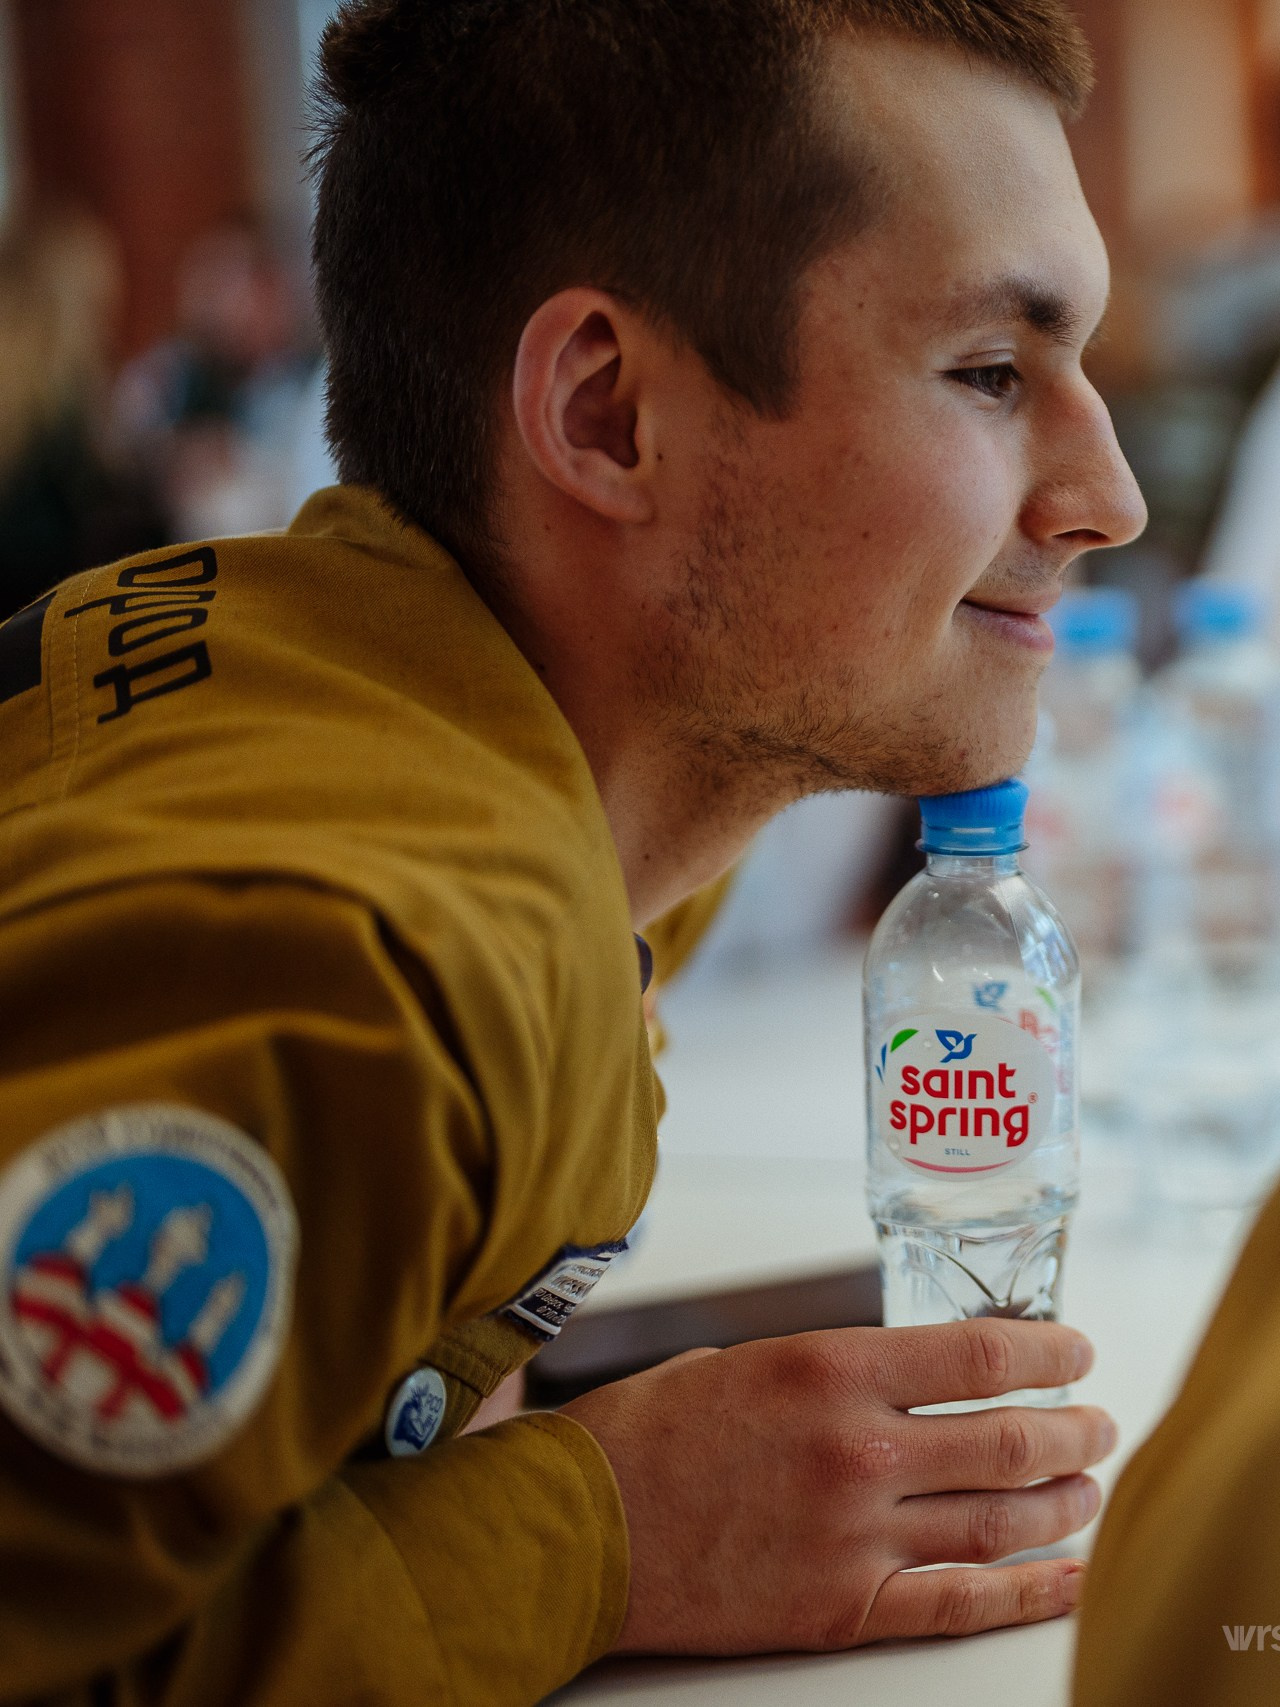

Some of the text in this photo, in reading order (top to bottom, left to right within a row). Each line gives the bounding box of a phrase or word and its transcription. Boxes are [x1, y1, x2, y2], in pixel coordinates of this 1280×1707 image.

[900, 1062, 1017, 1100] saint
[889, 1099, 1030, 1148] spring
[944, 1147, 971, 1156] STILL
